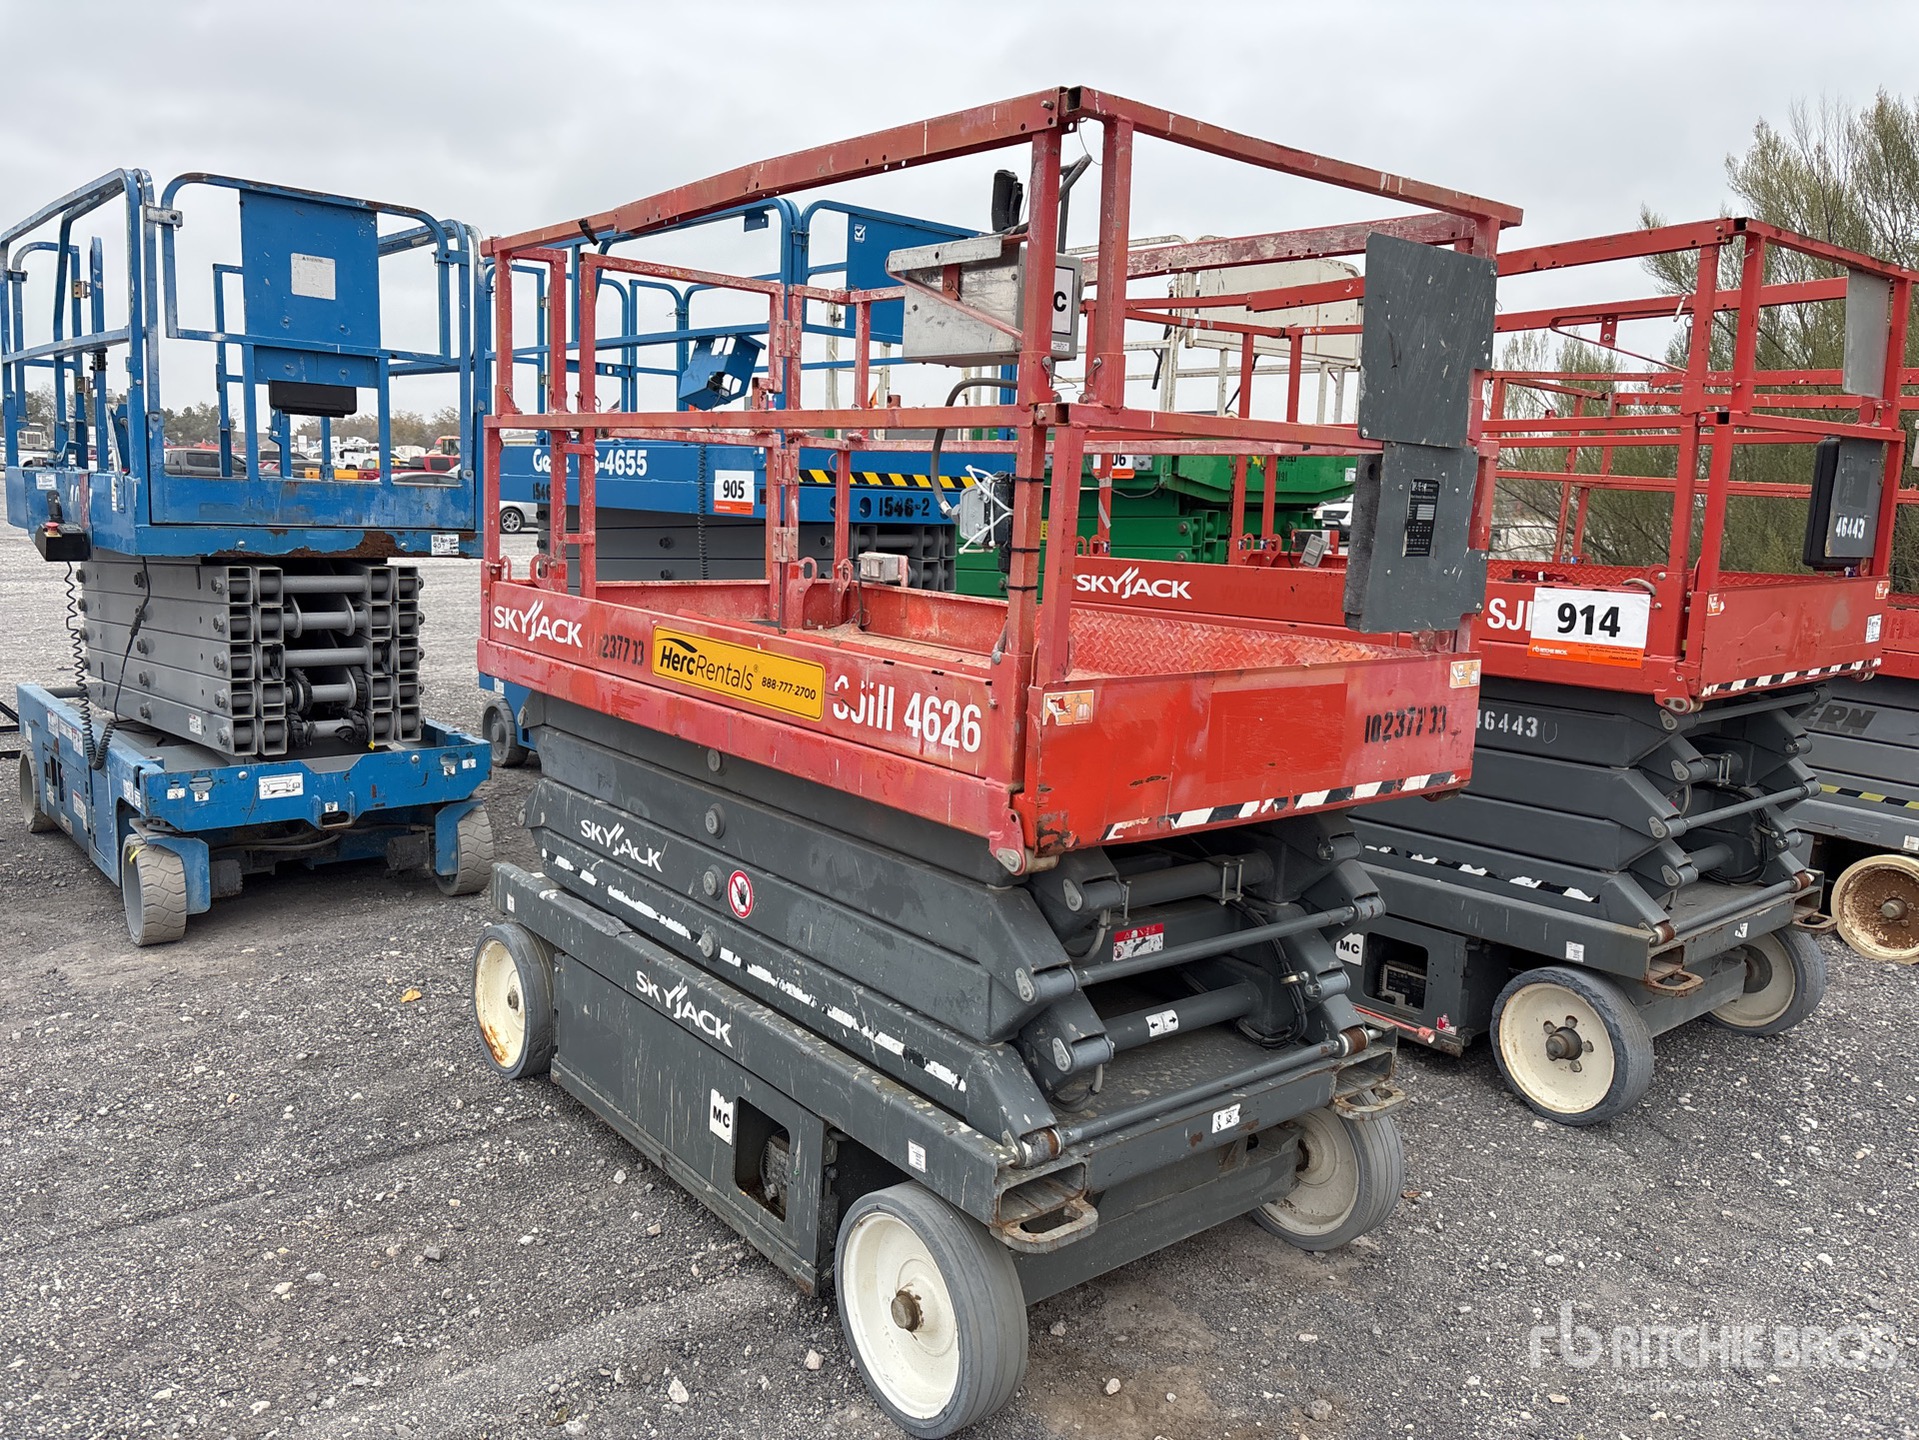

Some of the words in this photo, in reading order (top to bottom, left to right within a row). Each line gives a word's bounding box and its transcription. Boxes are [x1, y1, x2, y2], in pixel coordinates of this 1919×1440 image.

[723, 479, 745, 499] 905
[878, 496, 930, 518] 1546-2
[1835, 516, 1866, 540] 46443
[1075, 566, 1192, 600] SKYJACK
[493, 599, 583, 648] SKYJACK
[1557, 602, 1622, 638] 914
[761, 676, 817, 701] 888-777-2700
[903, 692, 982, 753] 4626
[580, 819, 663, 873] SKYJACK
[1340, 940, 1360, 955] MC
[635, 970, 734, 1049] SKYJACK
[713, 1104, 731, 1129] MC
